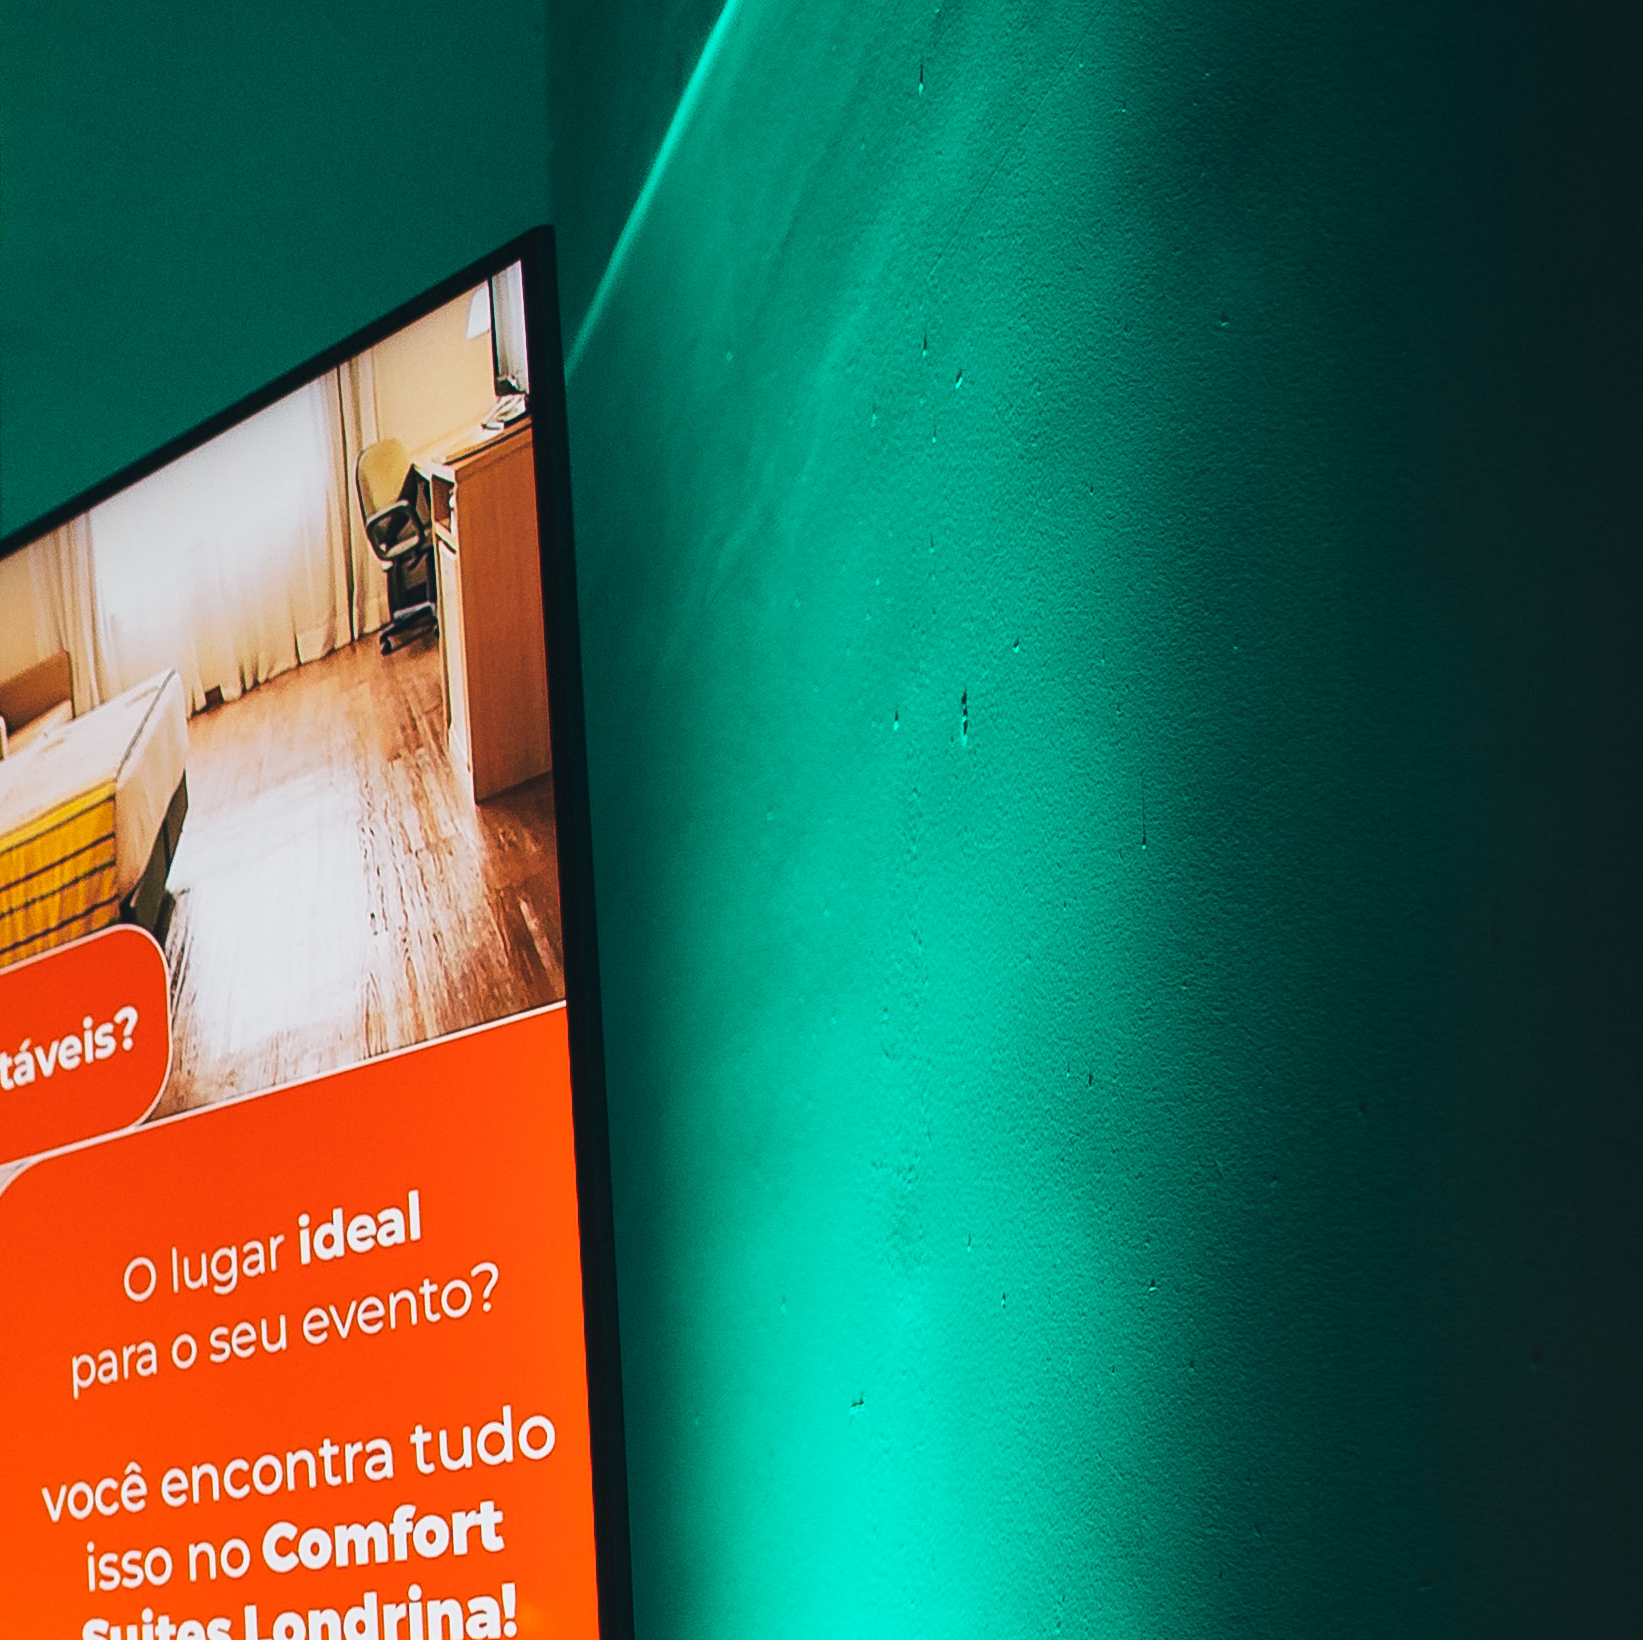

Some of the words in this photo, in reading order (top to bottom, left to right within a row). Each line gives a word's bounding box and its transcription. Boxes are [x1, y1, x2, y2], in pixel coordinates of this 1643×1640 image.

[123, 1256, 157, 1302] O
[171, 1234, 285, 1295] lugar
[298, 1189, 422, 1265] ideal
[71, 1341, 158, 1400] para
[171, 1333, 198, 1369] o
[209, 1314, 288, 1364] seu
[302, 1262, 500, 1345] evento?
[41, 1461, 148, 1523] você
[161, 1438, 394, 1507] encontra
[409, 1404, 556, 1475] tudo
[86, 1541, 173, 1592] isso
[188, 1537, 251, 1583] no
[262, 1500, 505, 1573] Comfort
